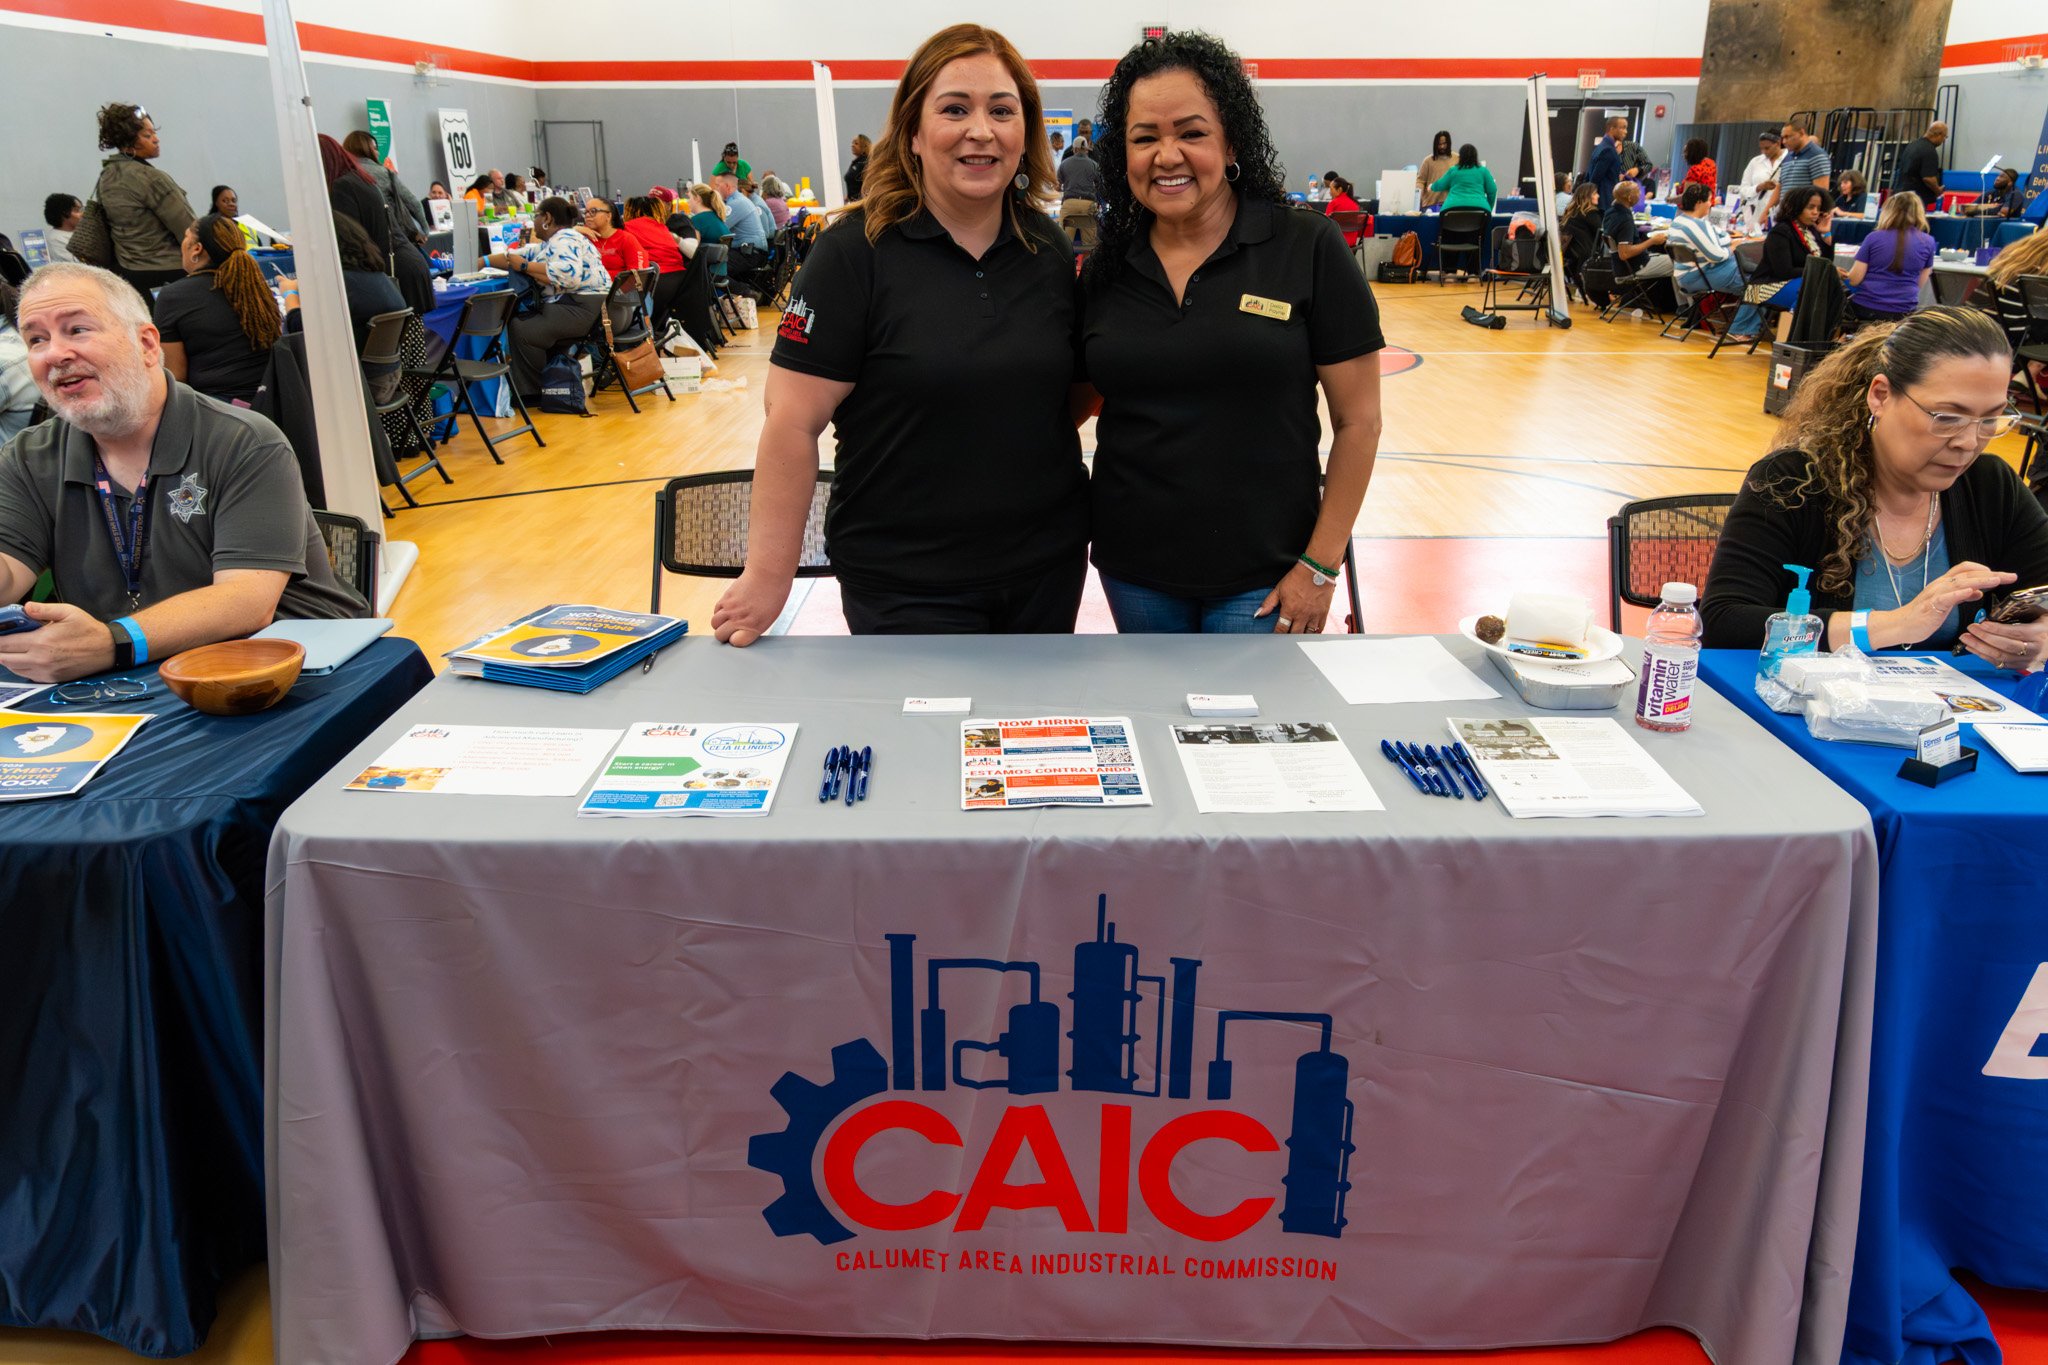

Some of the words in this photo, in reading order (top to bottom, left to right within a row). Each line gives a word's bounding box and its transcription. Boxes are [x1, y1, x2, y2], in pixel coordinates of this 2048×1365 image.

[447, 132, 472, 169] 160
[2033, 177, 2048, 186] Beh
[1648, 659, 1667, 717] vitamin
[1664, 660, 1680, 700] water
[1037, 718, 1090, 726] HIRING
[823, 1100, 1281, 1243] CAIC
[836, 1248, 949, 1273] CALUMET
[958, 1249, 1023, 1275] AREA
[1031, 1252, 1176, 1276] INDUSTRIAL
[1184, 1256, 1337, 1281] COMMISSION
